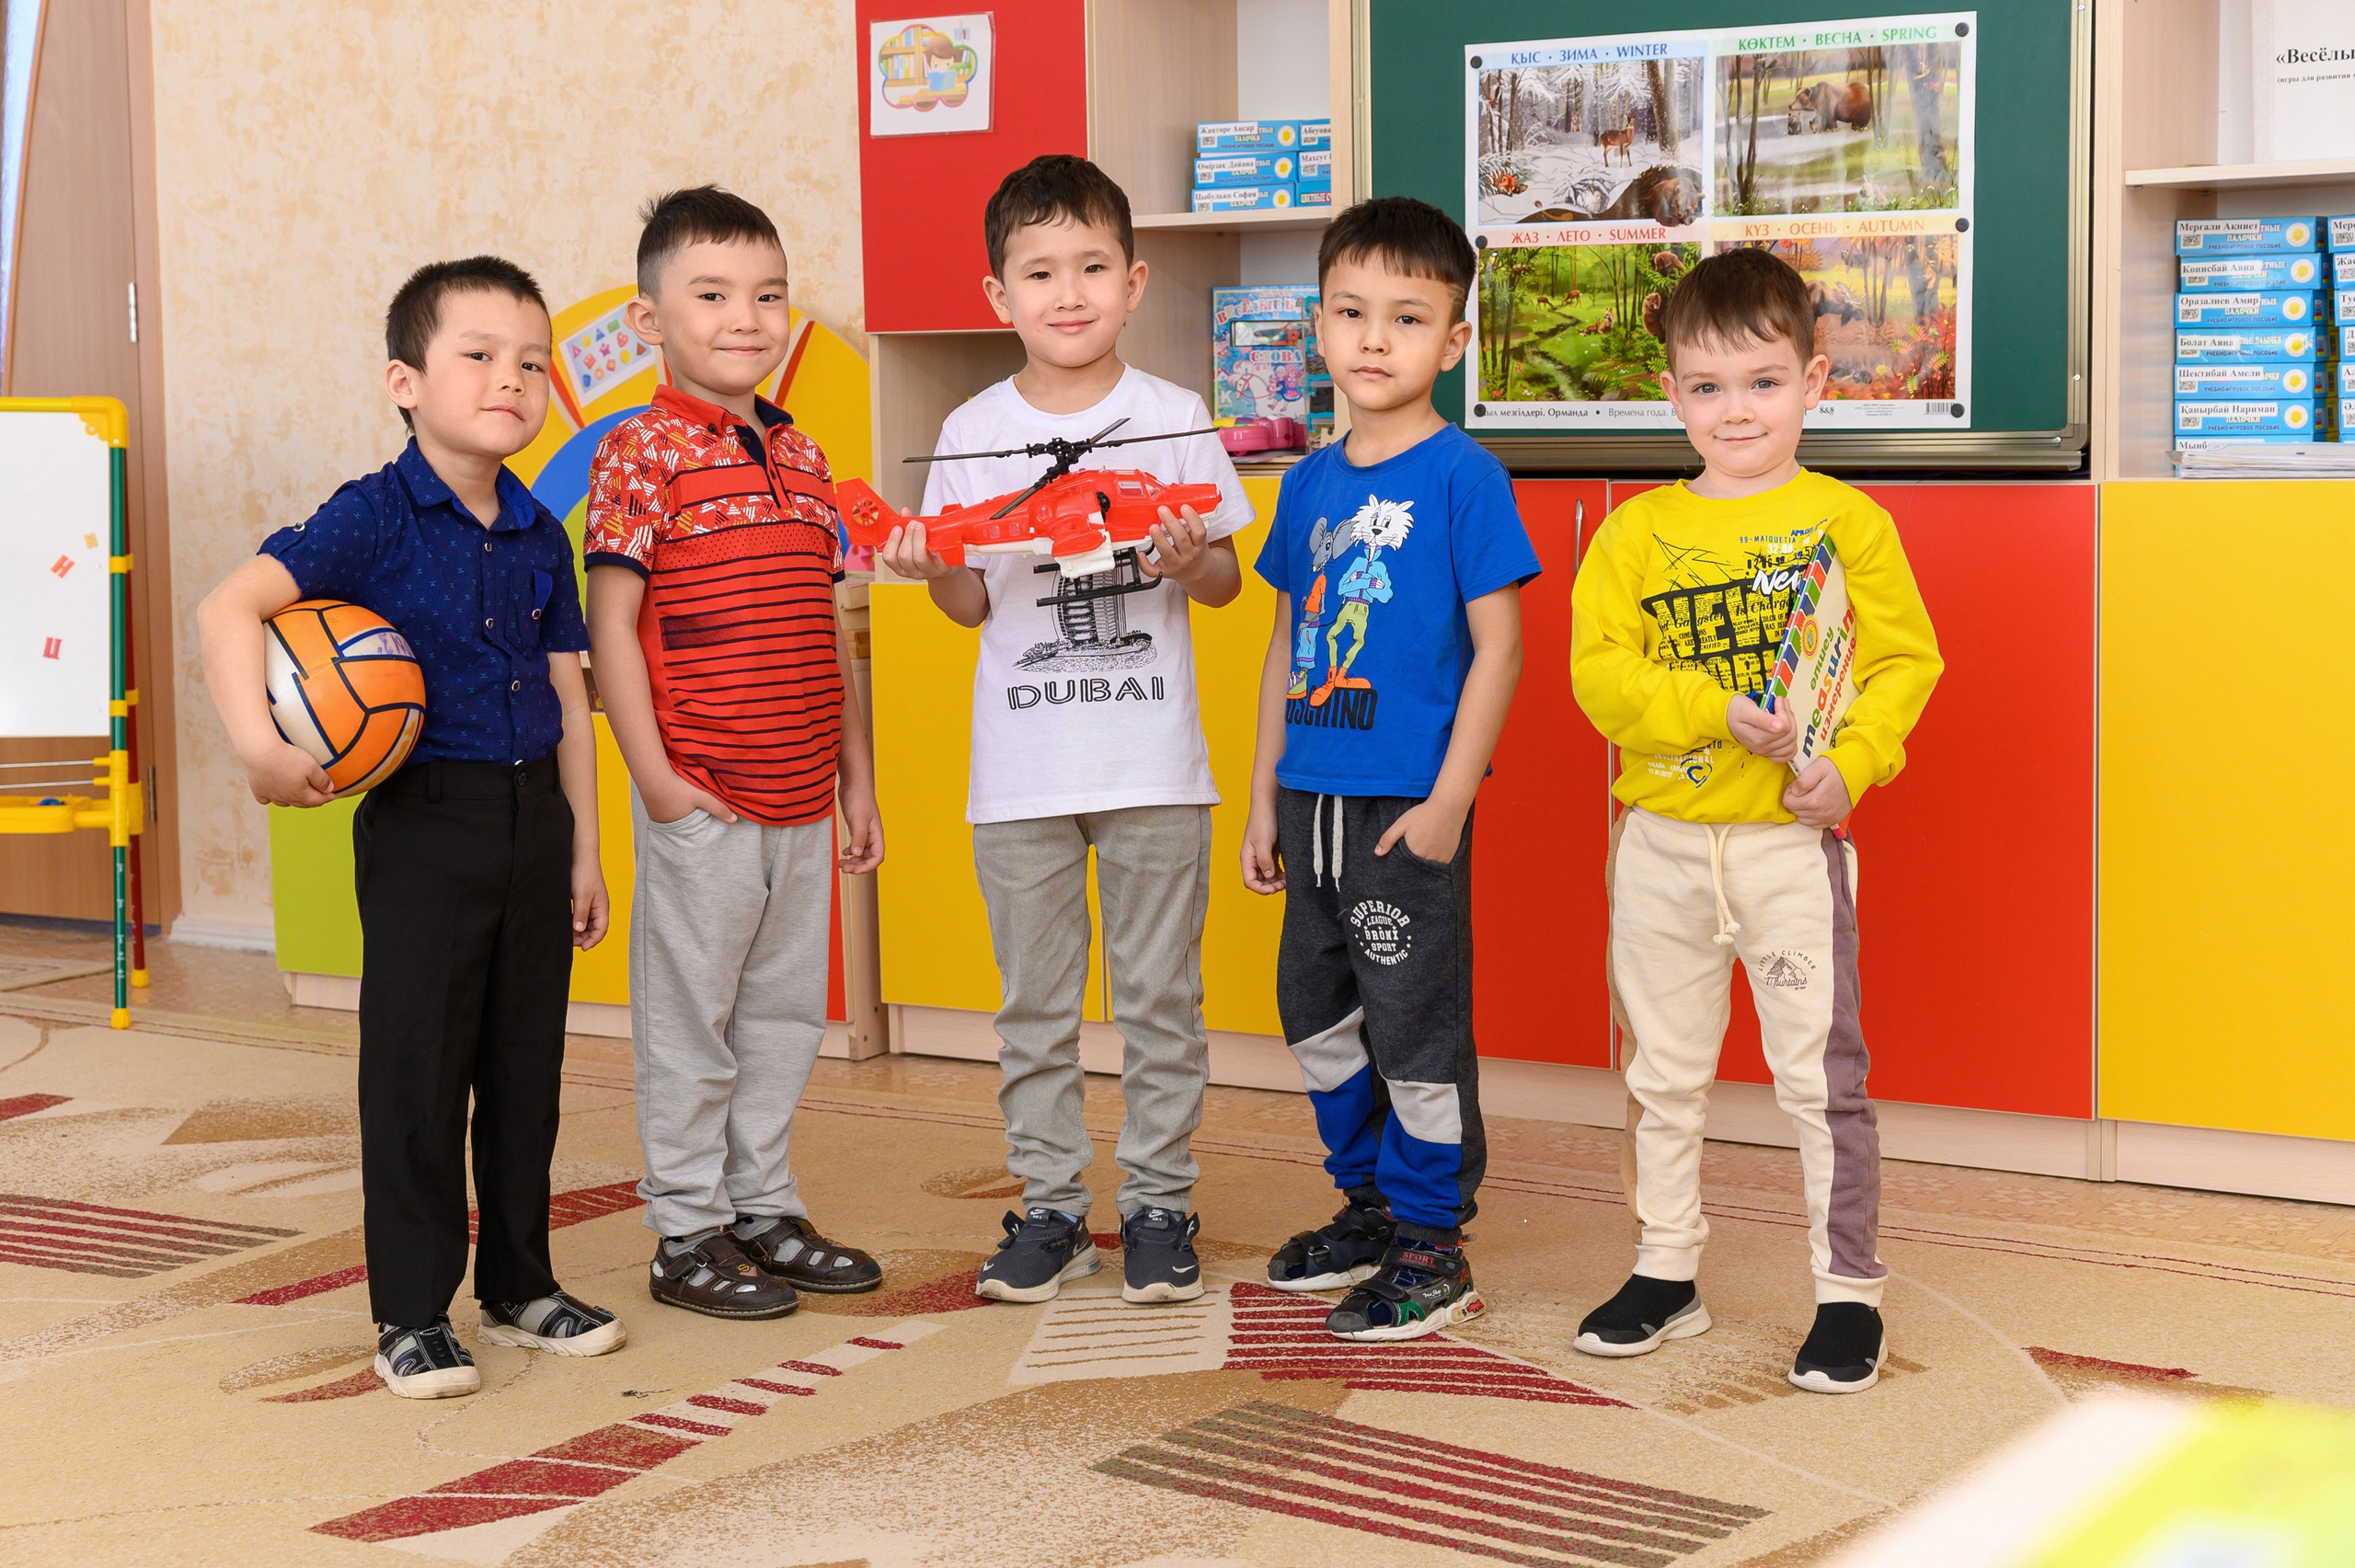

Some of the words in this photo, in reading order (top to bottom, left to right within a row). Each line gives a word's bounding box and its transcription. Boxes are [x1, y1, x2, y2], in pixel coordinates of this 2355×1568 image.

[1738, 35, 1796, 51] КӨКТЕМ
[1815, 31, 1862, 46] ВЕСНА
[1882, 26, 1937, 41] SPRING
[1511, 51, 1542, 66] ҚЫС
[1559, 48, 1599, 62] ЗИМА
[1616, 43, 1668, 58] WINTER
[1789, 222, 1838, 235] ОСЕНЬ
[1858, 219, 1925, 233] AUTUMN
[2259, 223, 2281, 232] ТНЫЕ
[1511, 232, 1539, 244] ЖАЗ
[1557, 230, 1591, 242] ЛЕТО
[1609, 227, 1666, 241] SUMMER
[2226, 234, 2262, 242] ПАЛОЧКИ
[2233, 297, 2259, 307] Амир
[2180, 338, 2208, 347] Болат
[1547, 407, 1589, 418] Орманда
[1608, 408, 1645, 418] Времена
[1647, 409, 1669, 418] года.
[2179, 441, 2210, 450] Мынб
[1802, 602, 1855, 759] measurin
[1007, 676, 1165, 710] DUBAI
[1821, 636, 1856, 742] измерение
[1350, 899, 1410, 928] SUPERIOR
[1366, 915, 1394, 926] LEAGUE
[1364, 930, 1399, 941] BRONX
[1371, 943, 1396, 952] SPORT
[1364, 948, 1408, 966] AUTHENTIC
[1758, 951, 1776, 971] LITTLE
[1781, 950, 1817, 970] CLIMBER
[1403, 1252, 1436, 1265] SPORT
